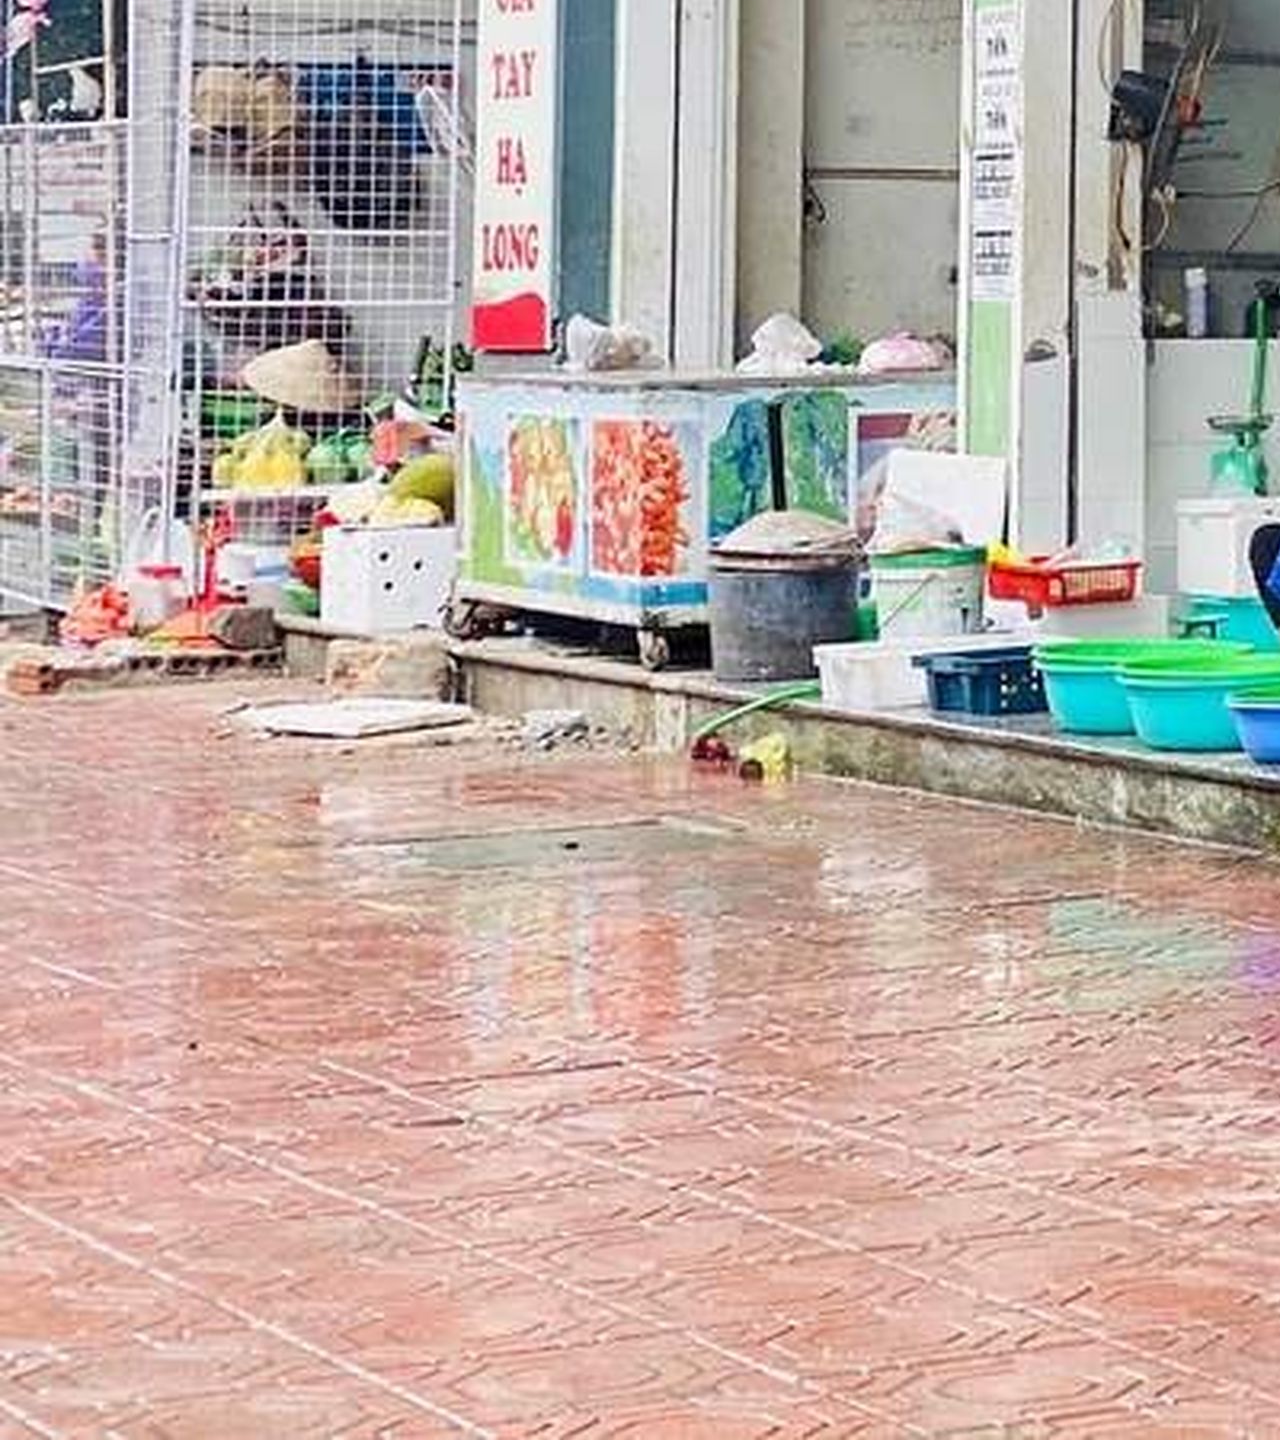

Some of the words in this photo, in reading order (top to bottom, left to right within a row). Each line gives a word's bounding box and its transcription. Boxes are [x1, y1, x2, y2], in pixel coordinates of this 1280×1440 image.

[493, 50, 536, 100] TAY
[497, 136, 528, 196] HẠ
[482, 224, 539, 272] LONG
